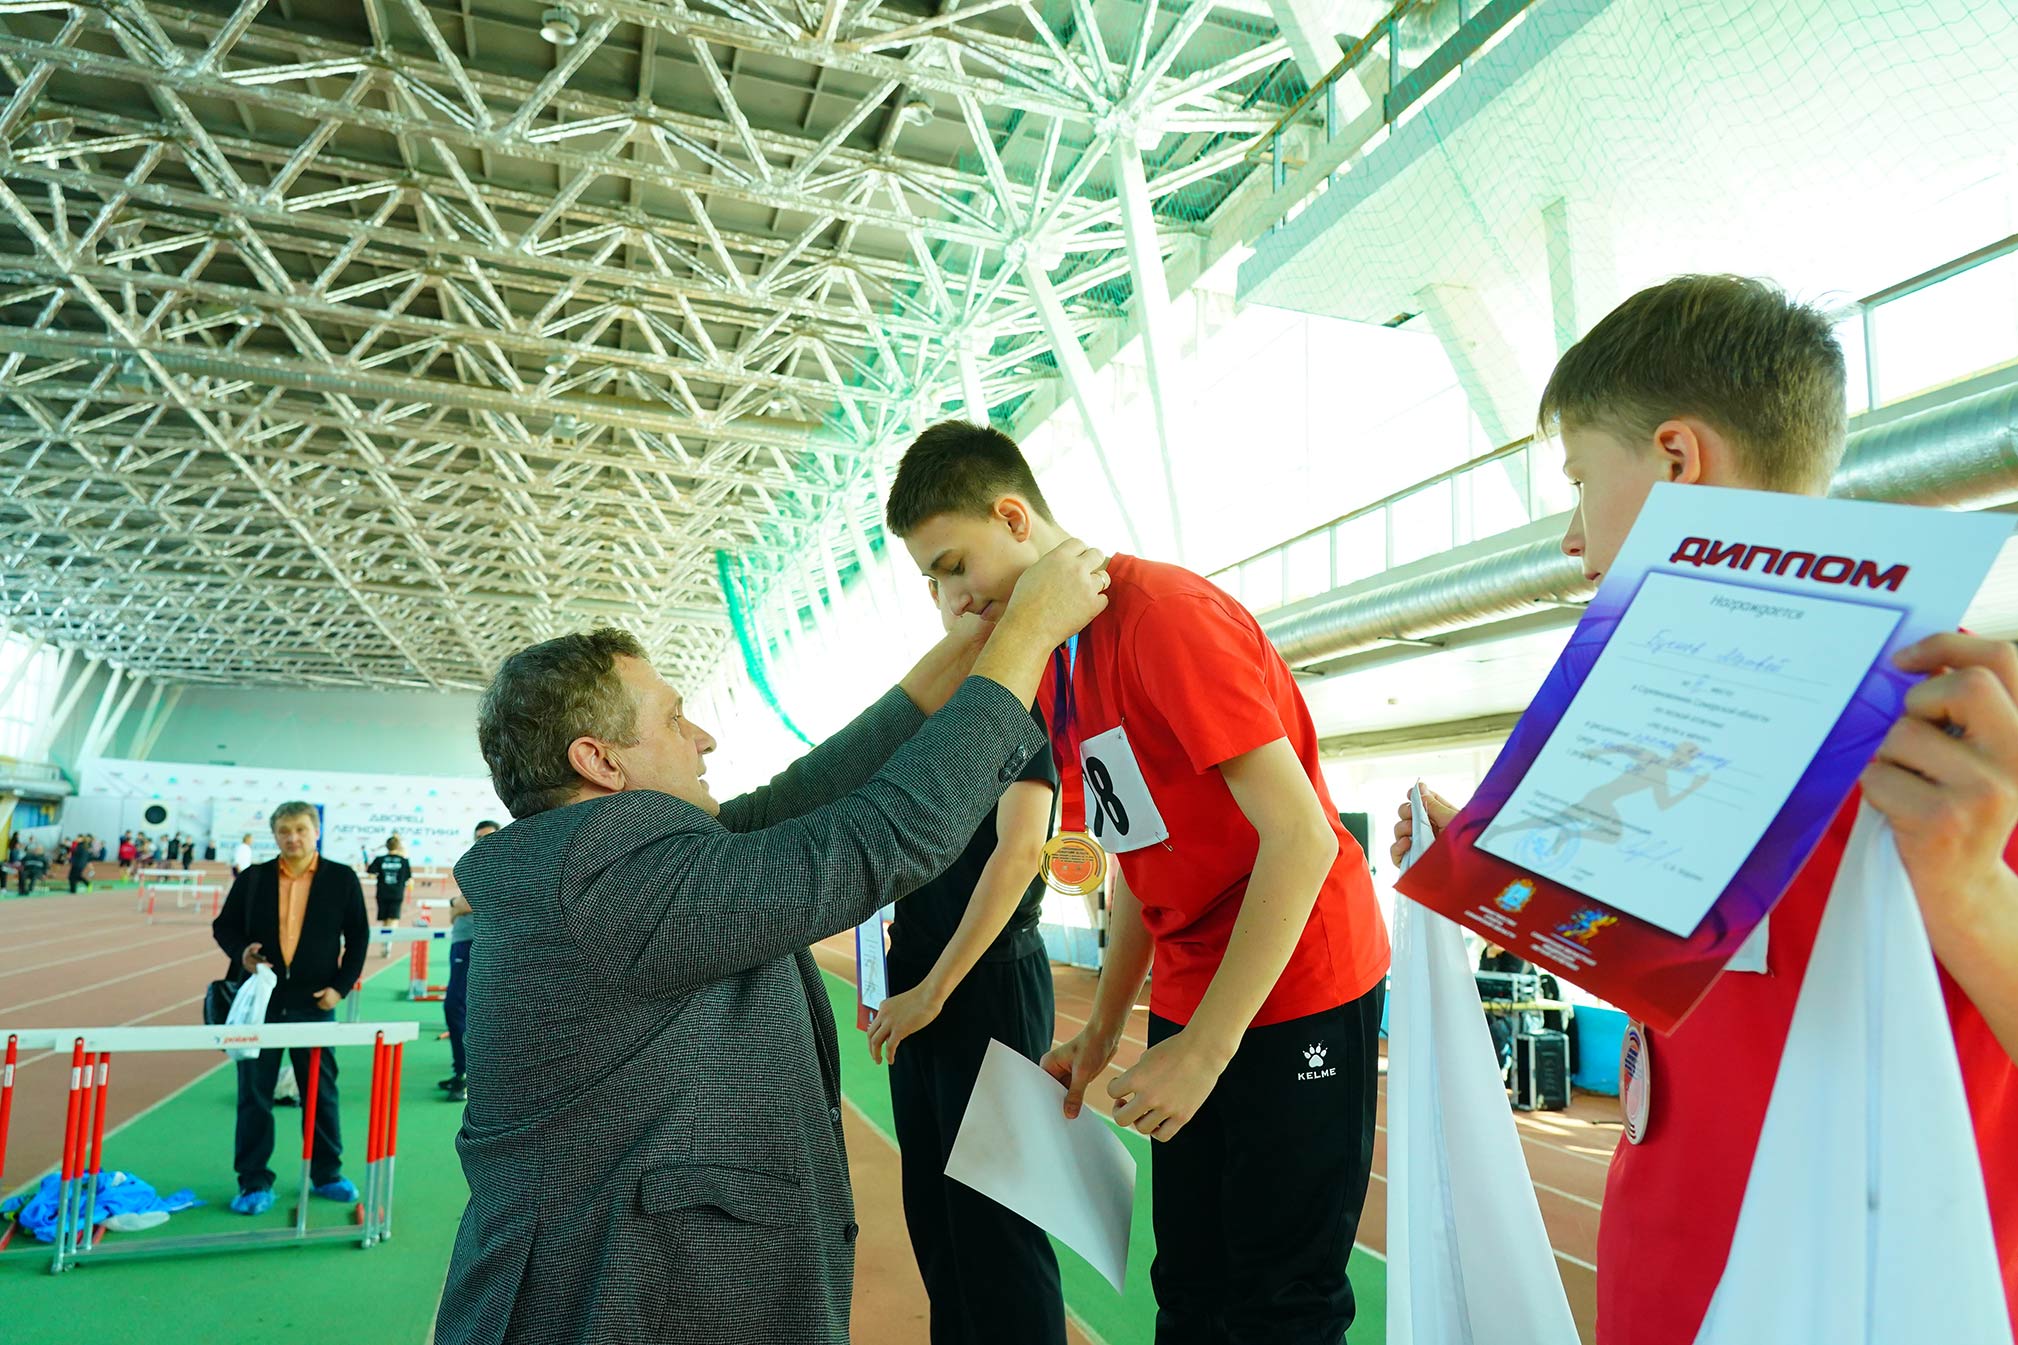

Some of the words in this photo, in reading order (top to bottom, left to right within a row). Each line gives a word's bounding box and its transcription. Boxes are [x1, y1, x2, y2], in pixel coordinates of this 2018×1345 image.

[1669, 536, 1910, 592] ДИПЛОМ
[1709, 594, 1805, 621] Награждается
[369, 813, 424, 823] ДВОРЕЦ
[1297, 1067, 1337, 1081] KELME
